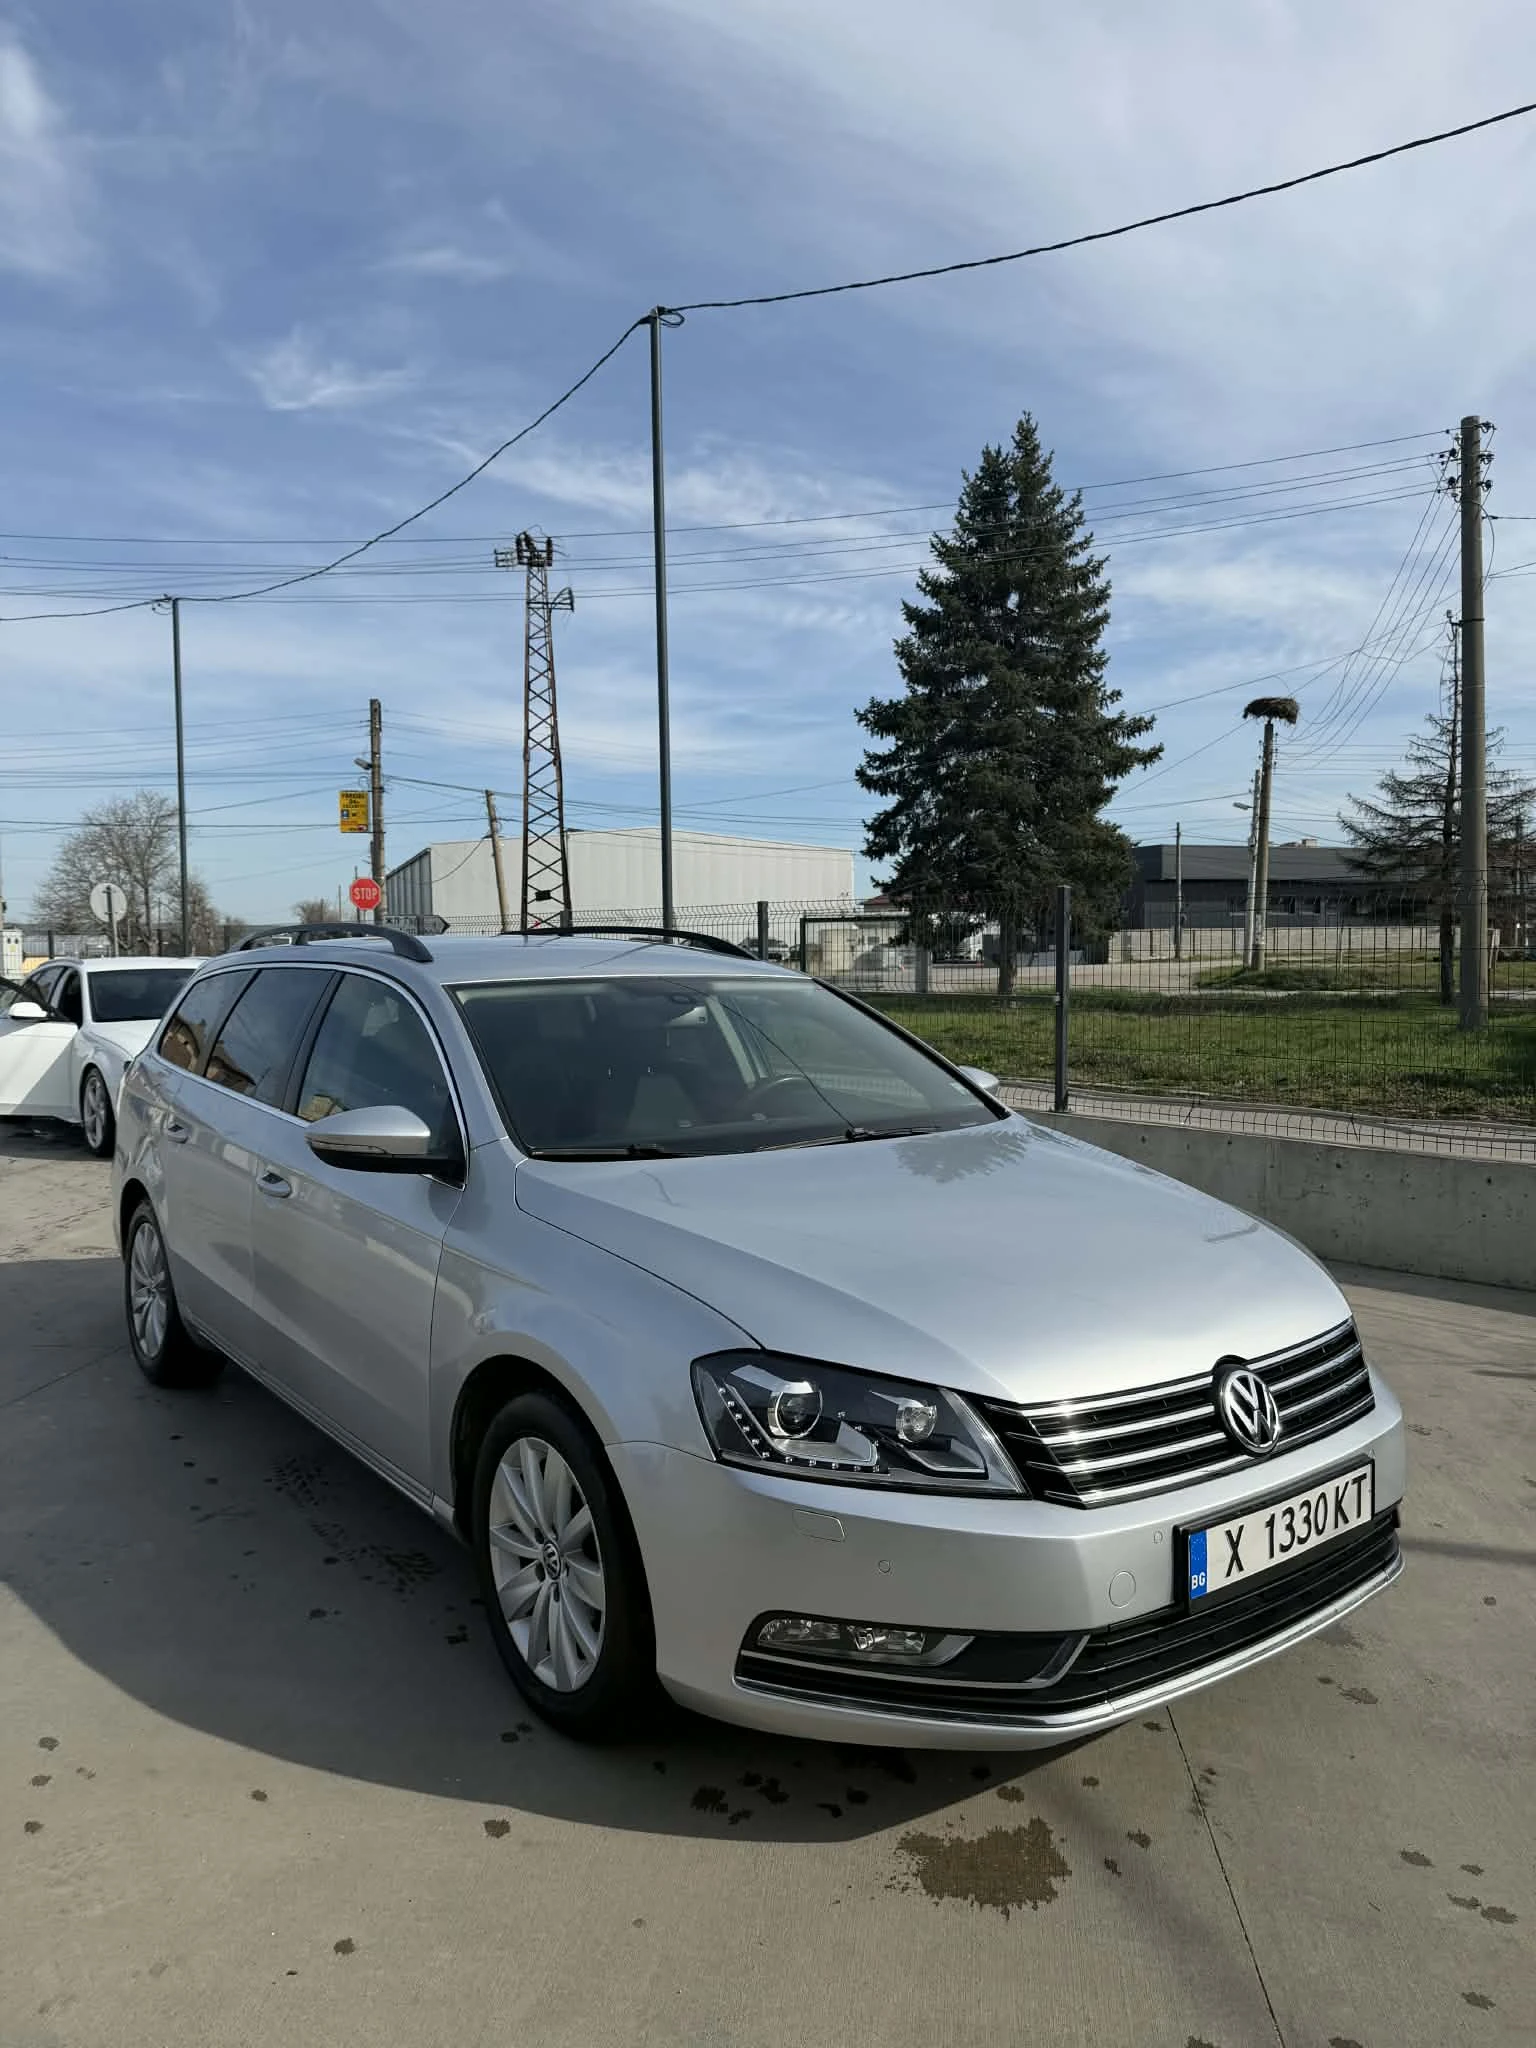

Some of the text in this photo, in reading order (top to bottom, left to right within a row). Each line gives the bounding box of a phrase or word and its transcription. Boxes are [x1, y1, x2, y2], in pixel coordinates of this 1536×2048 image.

[353, 887, 378, 900] STOP
[1223, 1369, 1280, 1453] VW
[1224, 1524, 1245, 1579] X
[1191, 1572, 1206, 1590] BG
